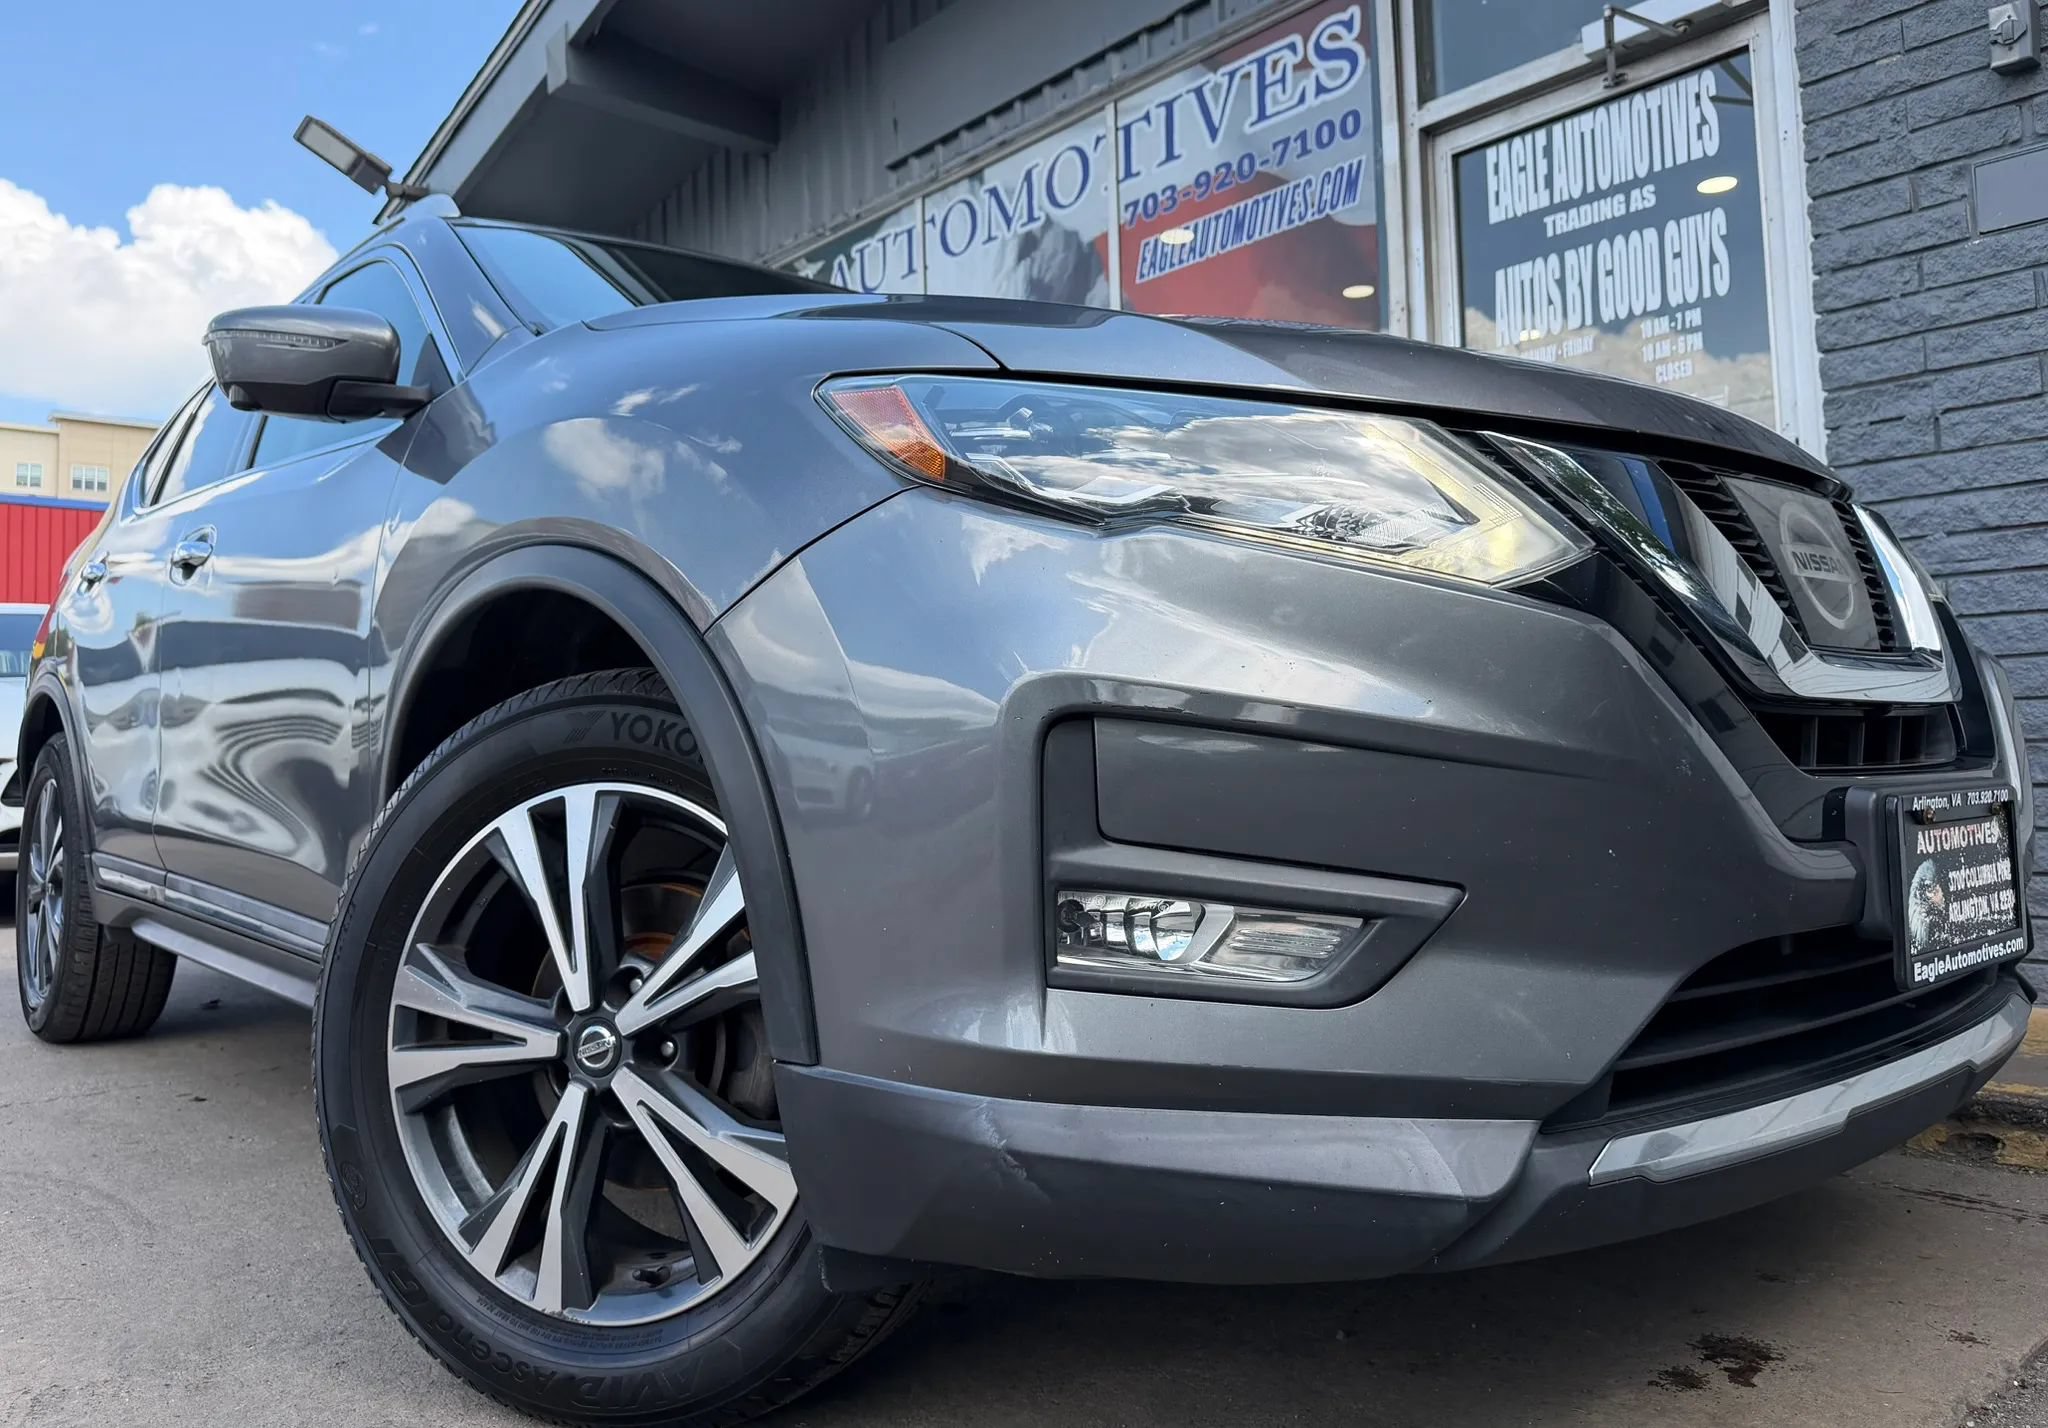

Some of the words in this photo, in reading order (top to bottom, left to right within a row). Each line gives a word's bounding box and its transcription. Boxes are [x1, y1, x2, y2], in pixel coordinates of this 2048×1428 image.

[833, 11, 1362, 293] AUTOMOTIVES
[1125, 109, 1361, 227] 703-920-7100
[1486, 127, 1550, 225] EAGLE
[1551, 69, 1720, 204] AUTOMOTIVES
[1138, 157, 1364, 281] EAGLEAUTOMOTIVES.COM
[1544, 195, 1626, 237] TRADING
[1630, 184, 1656, 212] AS
[1495, 253, 1563, 347] AUTOS
[1565, 245, 1594, 331] BY
[1597, 226, 1662, 324] GOOD
[1664, 207, 1730, 308] GUYS
[1676, 312, 1683, 330] 7
[1685, 307, 1702, 328] PM
[611, 711, 704, 763] YOKO
[1913, 796, 1949, 811] Arlington,
[1951, 793, 1962, 807] VA
[1917, 819, 2000, 854] AUTOMOTIVES
[1914, 936, 2024, 983] EagleAutomotives.com
